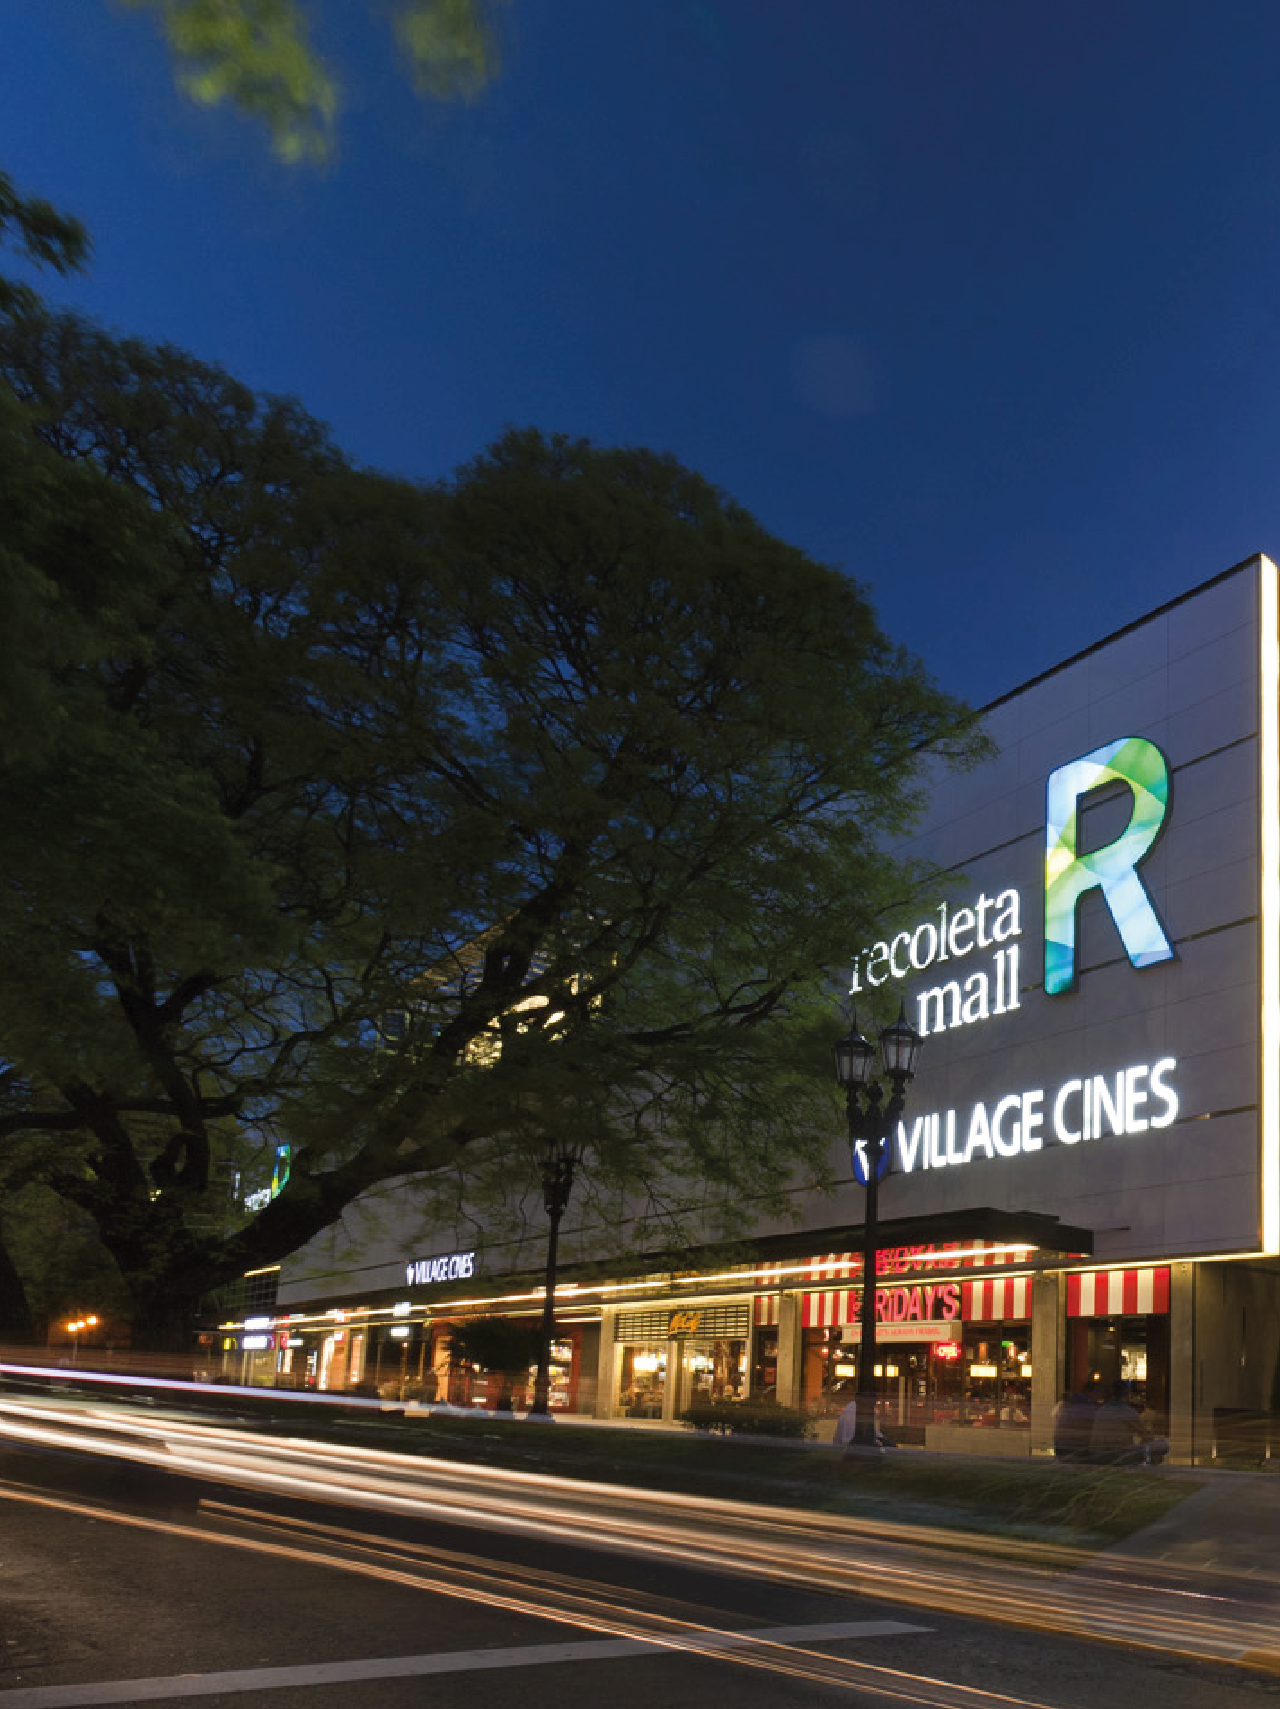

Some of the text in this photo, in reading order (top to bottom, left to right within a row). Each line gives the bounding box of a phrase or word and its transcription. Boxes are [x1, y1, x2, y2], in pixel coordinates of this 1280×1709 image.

[1045, 737, 1174, 995] R
[848, 888, 1022, 996] recoleta
[916, 943, 1021, 1037] mall
[897, 1057, 1179, 1173] VILLAGE CINES
